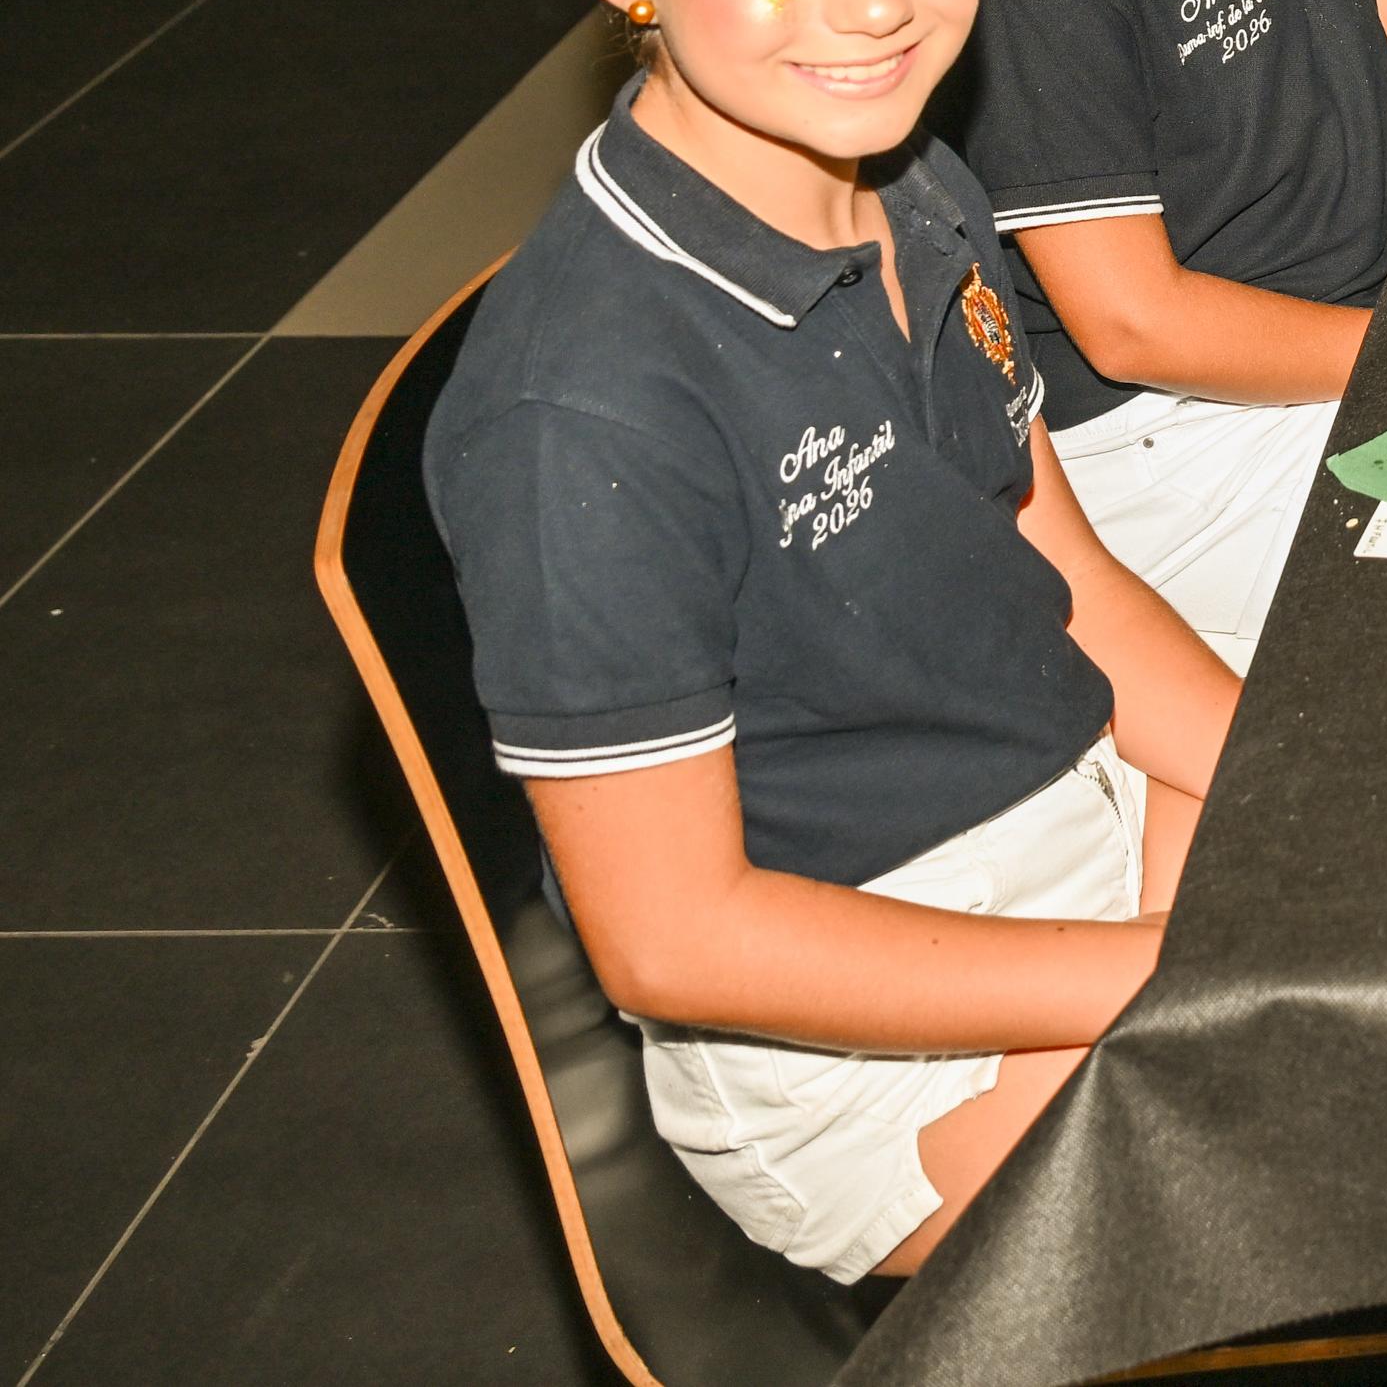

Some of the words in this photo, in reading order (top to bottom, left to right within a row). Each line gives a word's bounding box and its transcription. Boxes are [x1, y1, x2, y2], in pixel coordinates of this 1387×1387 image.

[1222, 9, 1272, 64] 2026
[780, 425, 845, 483] Ana
[821, 420, 896, 501] Infantil
[812, 475, 874, 551] 2026
